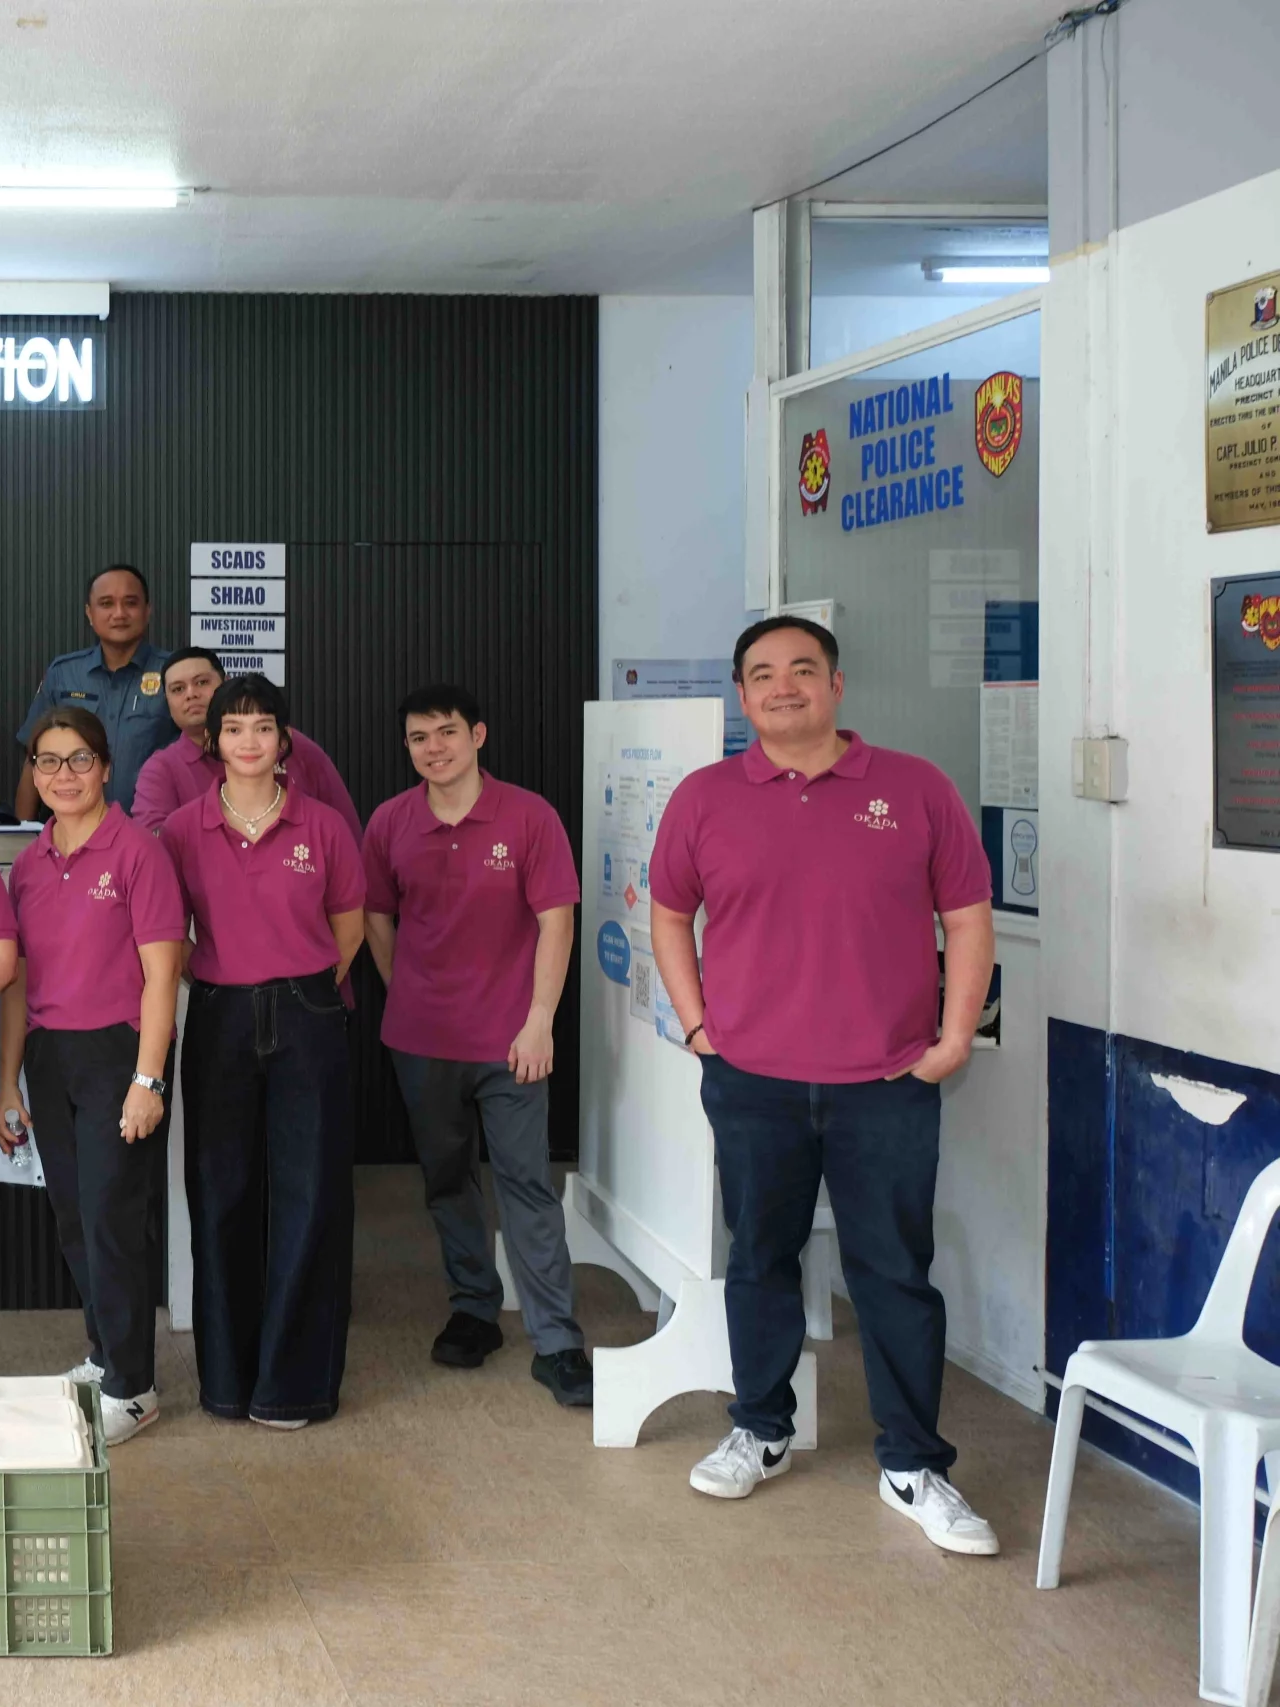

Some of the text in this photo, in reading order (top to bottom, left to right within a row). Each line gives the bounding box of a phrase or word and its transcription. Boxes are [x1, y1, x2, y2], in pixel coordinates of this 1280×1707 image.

[1210, 351, 1237, 399] MANILA
[1240, 335, 1270, 366] POLICE
[849, 372, 954, 440] NATIONAL
[1235, 389, 1274, 406] PRECINCT
[861, 425, 936, 482] POLICE
[1216, 443, 1240, 462] CAPT.
[1241, 437, 1267, 458] JULIO
[841, 465, 965, 532] CLEARANCE
[211, 550, 266, 570] SCADS
[210, 586, 266, 606] SHRAO
[200, 618, 276, 632] INVESTIGATION
[221, 634, 254, 646] ADMIN
[220, 656, 263, 670] URVIVOR
[853, 813, 898, 830] OKADA
[282, 859, 316, 873] OKADA
[483, 859, 515, 869] OKADA
[87, 887, 117, 898] OKADA
